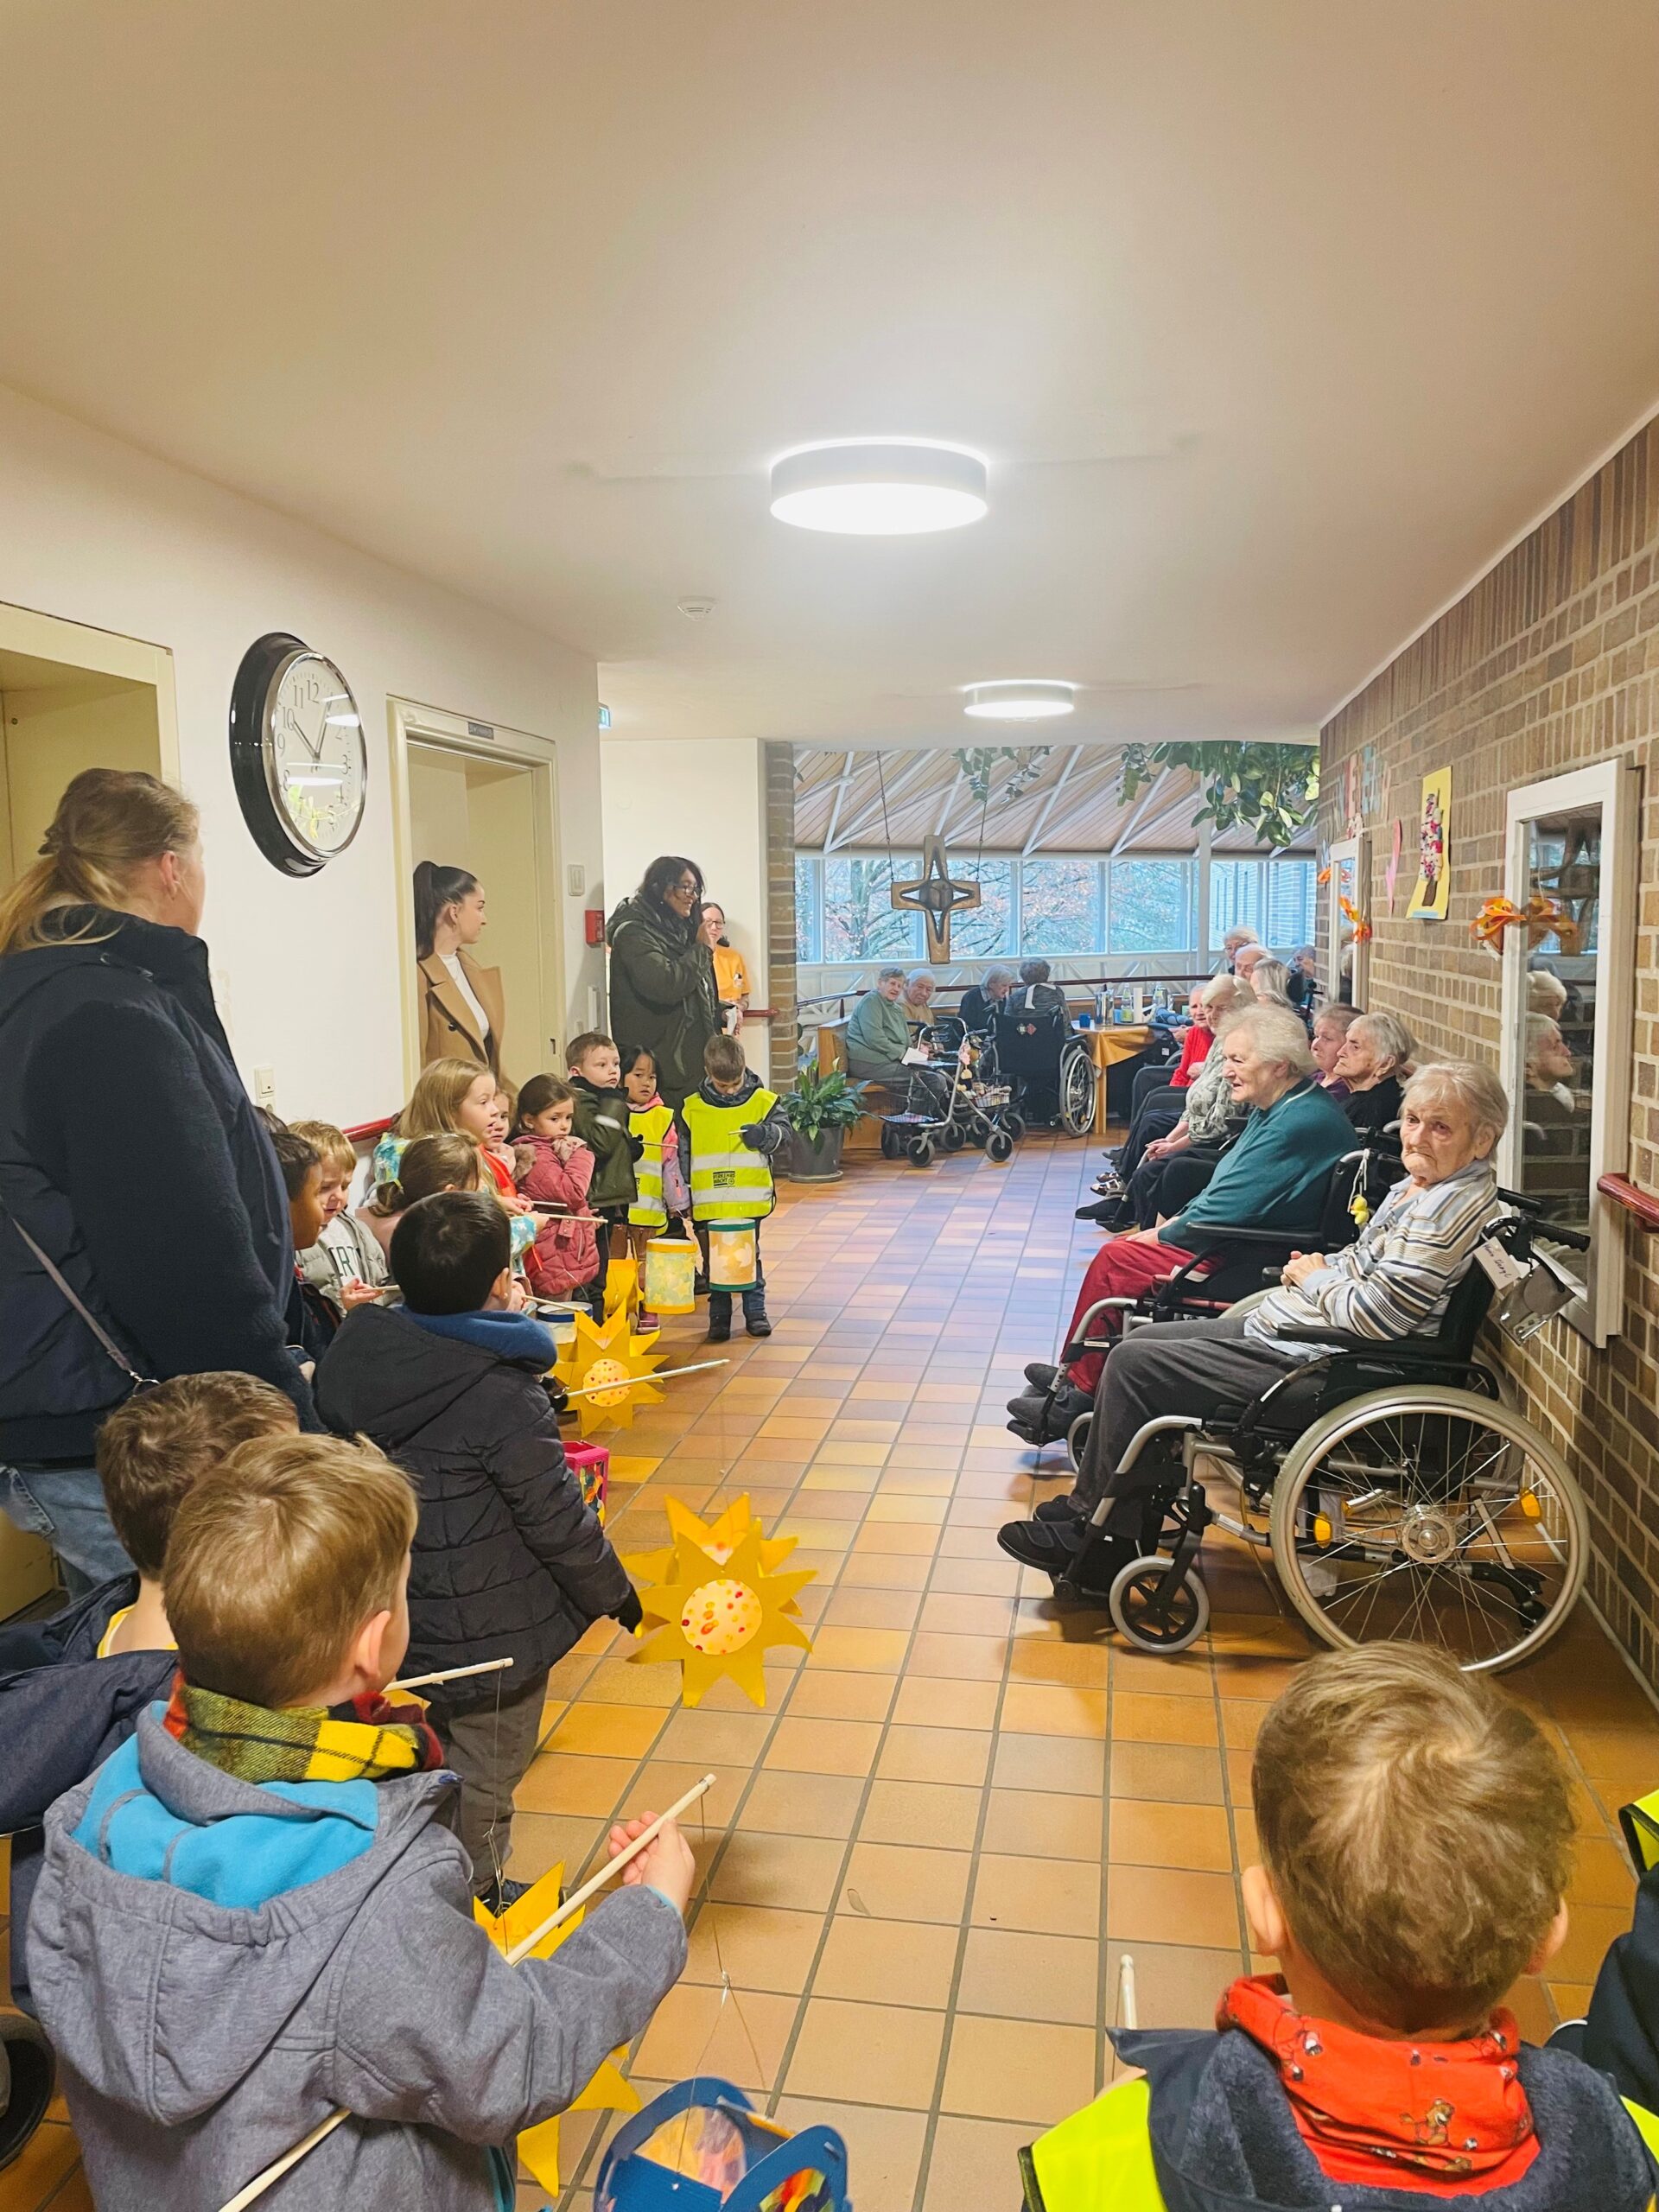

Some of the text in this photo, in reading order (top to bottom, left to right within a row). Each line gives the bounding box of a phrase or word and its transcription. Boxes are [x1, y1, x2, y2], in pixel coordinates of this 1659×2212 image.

[293, 684, 304, 709] 11
[306, 679, 320, 704] 12
[282, 706, 296, 731] 10
[276, 733, 286, 758] 9
[340, 753, 349, 775] 3
